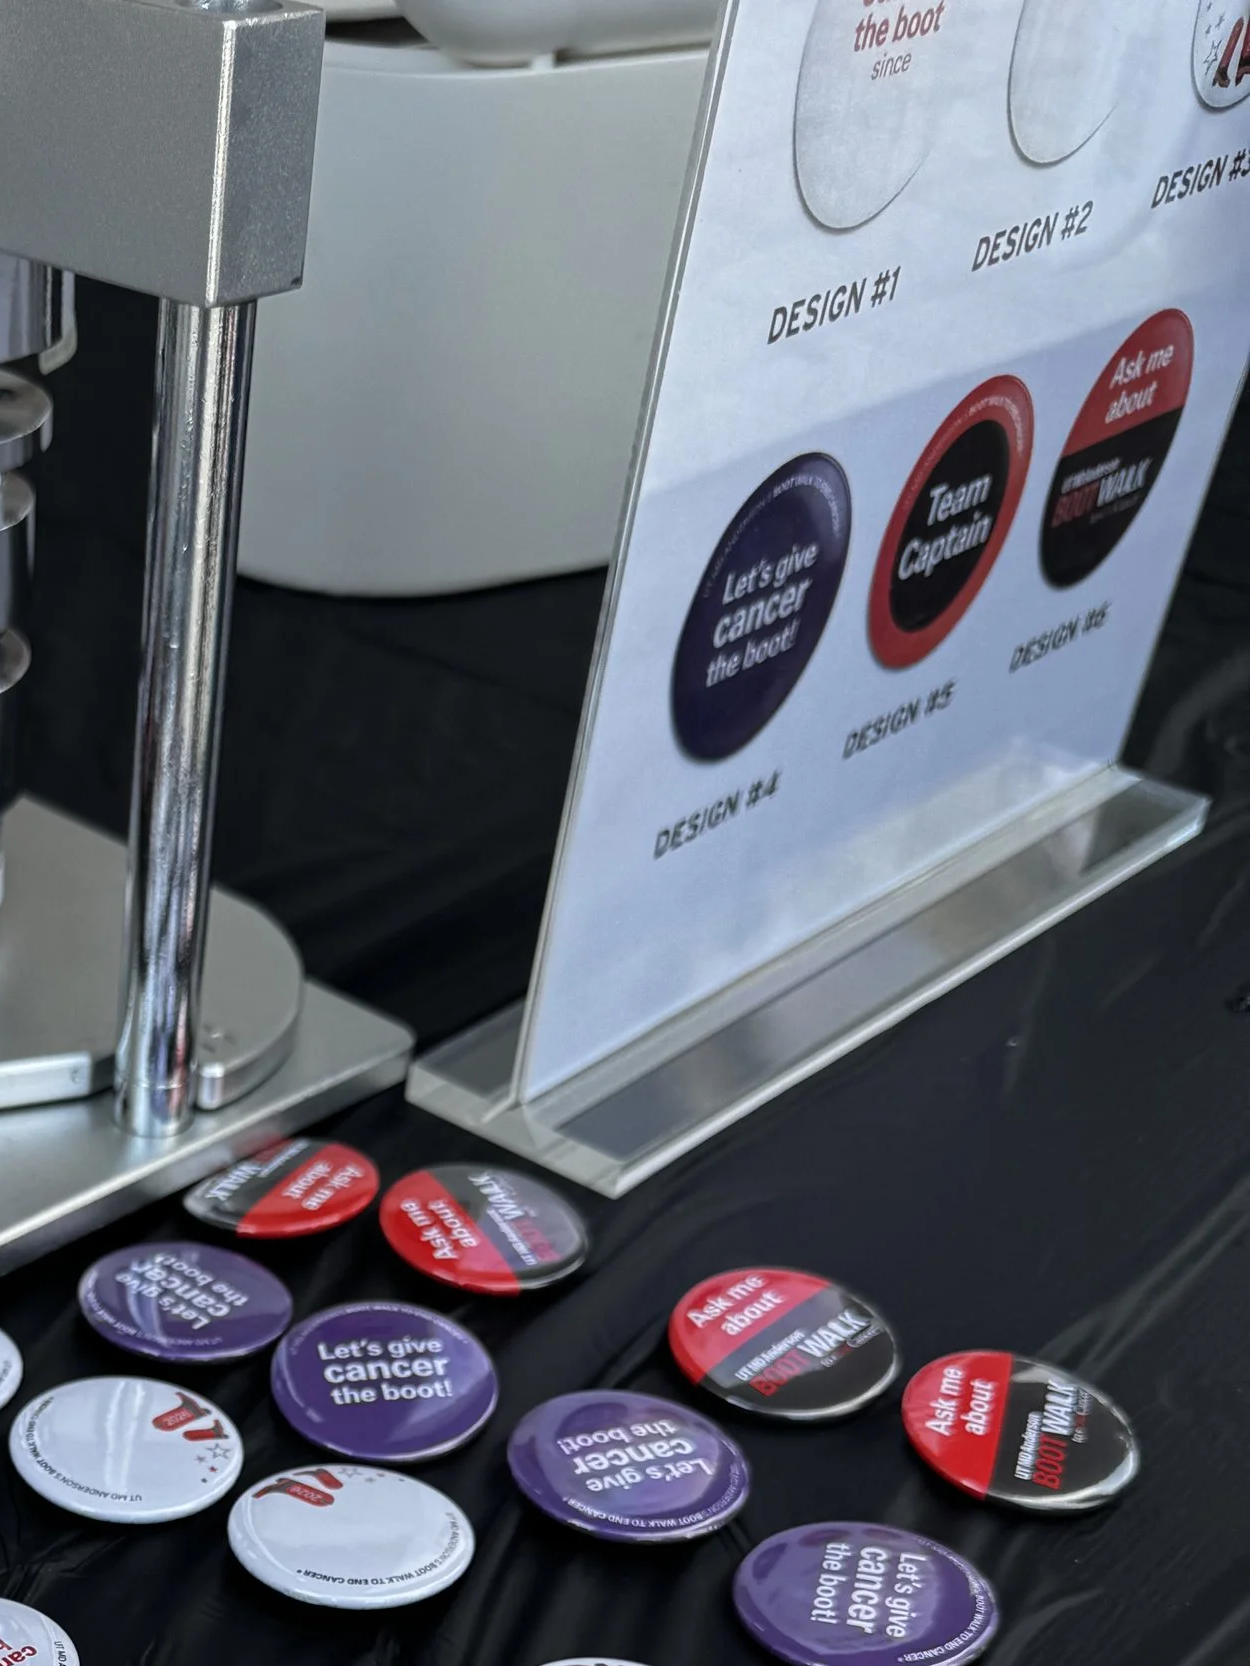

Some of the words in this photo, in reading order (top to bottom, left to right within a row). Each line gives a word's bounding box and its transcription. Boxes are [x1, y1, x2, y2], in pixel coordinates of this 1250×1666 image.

[854, 14, 889, 53] the
[892, 1, 945, 42] boot
[871, 51, 912, 80] since
[1151, 155, 1227, 208] DESIGN
[972, 212, 1058, 272] DESIGN
[1061, 201, 1094, 240] #2
[768, 278, 867, 344] DESIGN
[871, 266, 902, 308] #1
[1109, 350, 1144, 390] Ask
[1147, 345, 1174, 374] me
[1105, 381, 1158, 424] about
[928, 474, 992, 527] Team
[898, 512, 994, 580] Captain
[722, 563, 773, 606] Let's
[775, 541, 818, 587] give
[713, 581, 811, 649] cancer
[705, 650, 740, 687] the
[742, 624, 798, 671] boot!
[843, 701, 919, 760] DESIGN
[654, 789, 740, 860] DESIGN
[745, 770, 781, 809] #4
[687, 1296, 732, 1328] Ask
[726, 1275, 766, 1300] me
[721, 1289, 783, 1336] about
[318, 1338, 383, 1361] Let's
[387, 1335, 444, 1359] give
[323, 1356, 450, 1384] cancer
[749, 1349, 811, 1397] BOOT
[796, 1308, 871, 1358] WALK
[330, 1386, 377, 1406] the
[381, 1379, 453, 1401] boot!
[940, 1366, 964, 1396] me
[960, 1378, 995, 1435] about
[630, 1420, 680, 1439] the
[925, 1399, 958, 1436] Ask
[1040, 1379, 1077, 1435] WALK
[556, 1427, 630, 1456] boot!
[572, 1438, 696, 1475] cancer
[1032, 1432, 1069, 1490] BOOT
[585, 1468, 644, 1493] give
[645, 1457, 716, 1482] Let's
[822, 1543, 851, 1572] the
[893, 1552, 928, 1595] Let's
[810, 1573, 847, 1624] boot!
[846, 1546, 889, 1634] cancer
[885, 1596, 918, 1639] give
